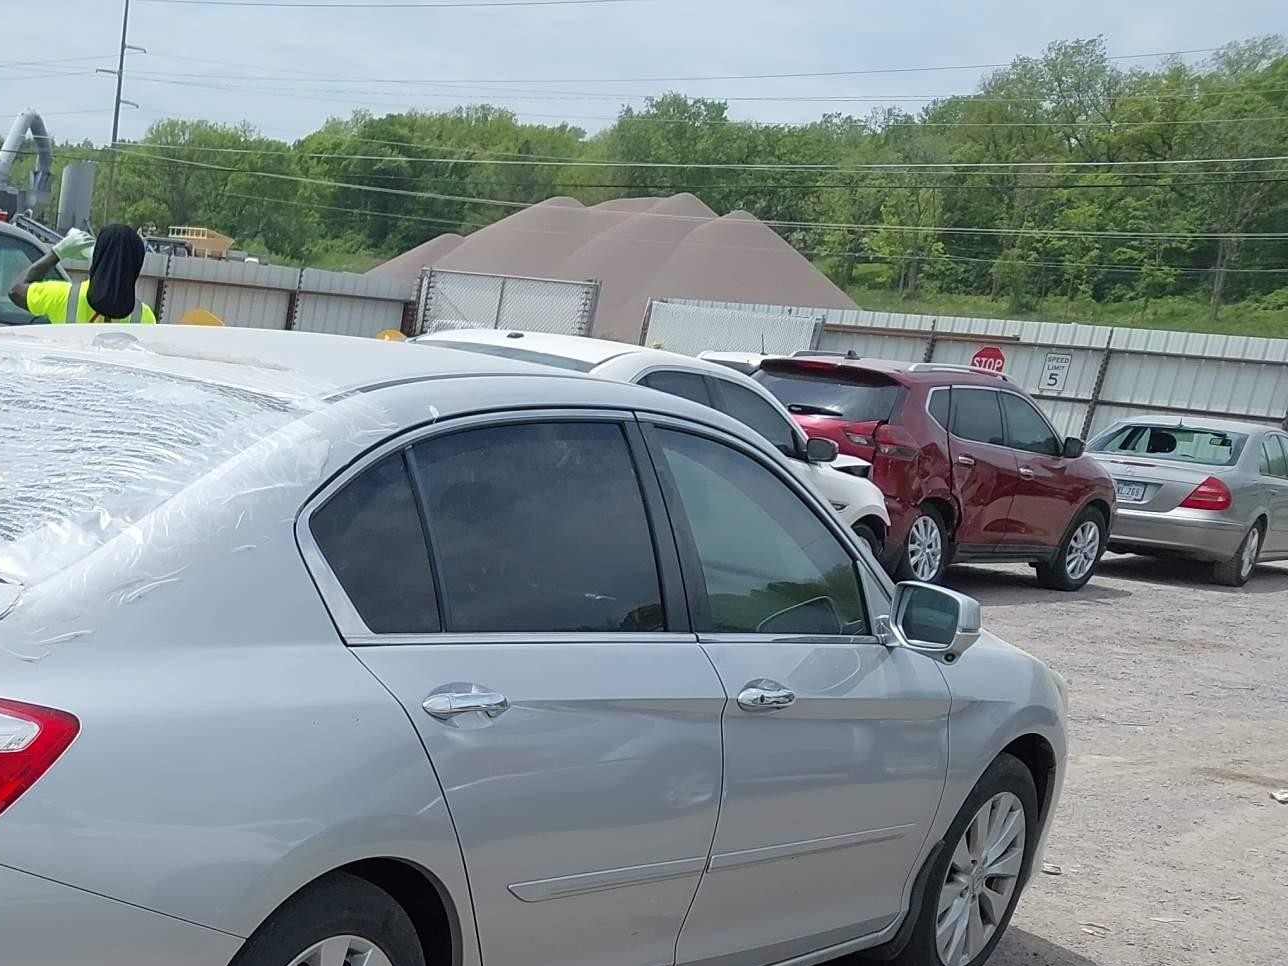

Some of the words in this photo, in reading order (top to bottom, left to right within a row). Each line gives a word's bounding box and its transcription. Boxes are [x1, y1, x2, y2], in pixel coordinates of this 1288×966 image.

[973, 357, 1003, 372] STOP
[1047, 356, 1069, 364] SPEED
[1047, 373, 1059, 386] 5
